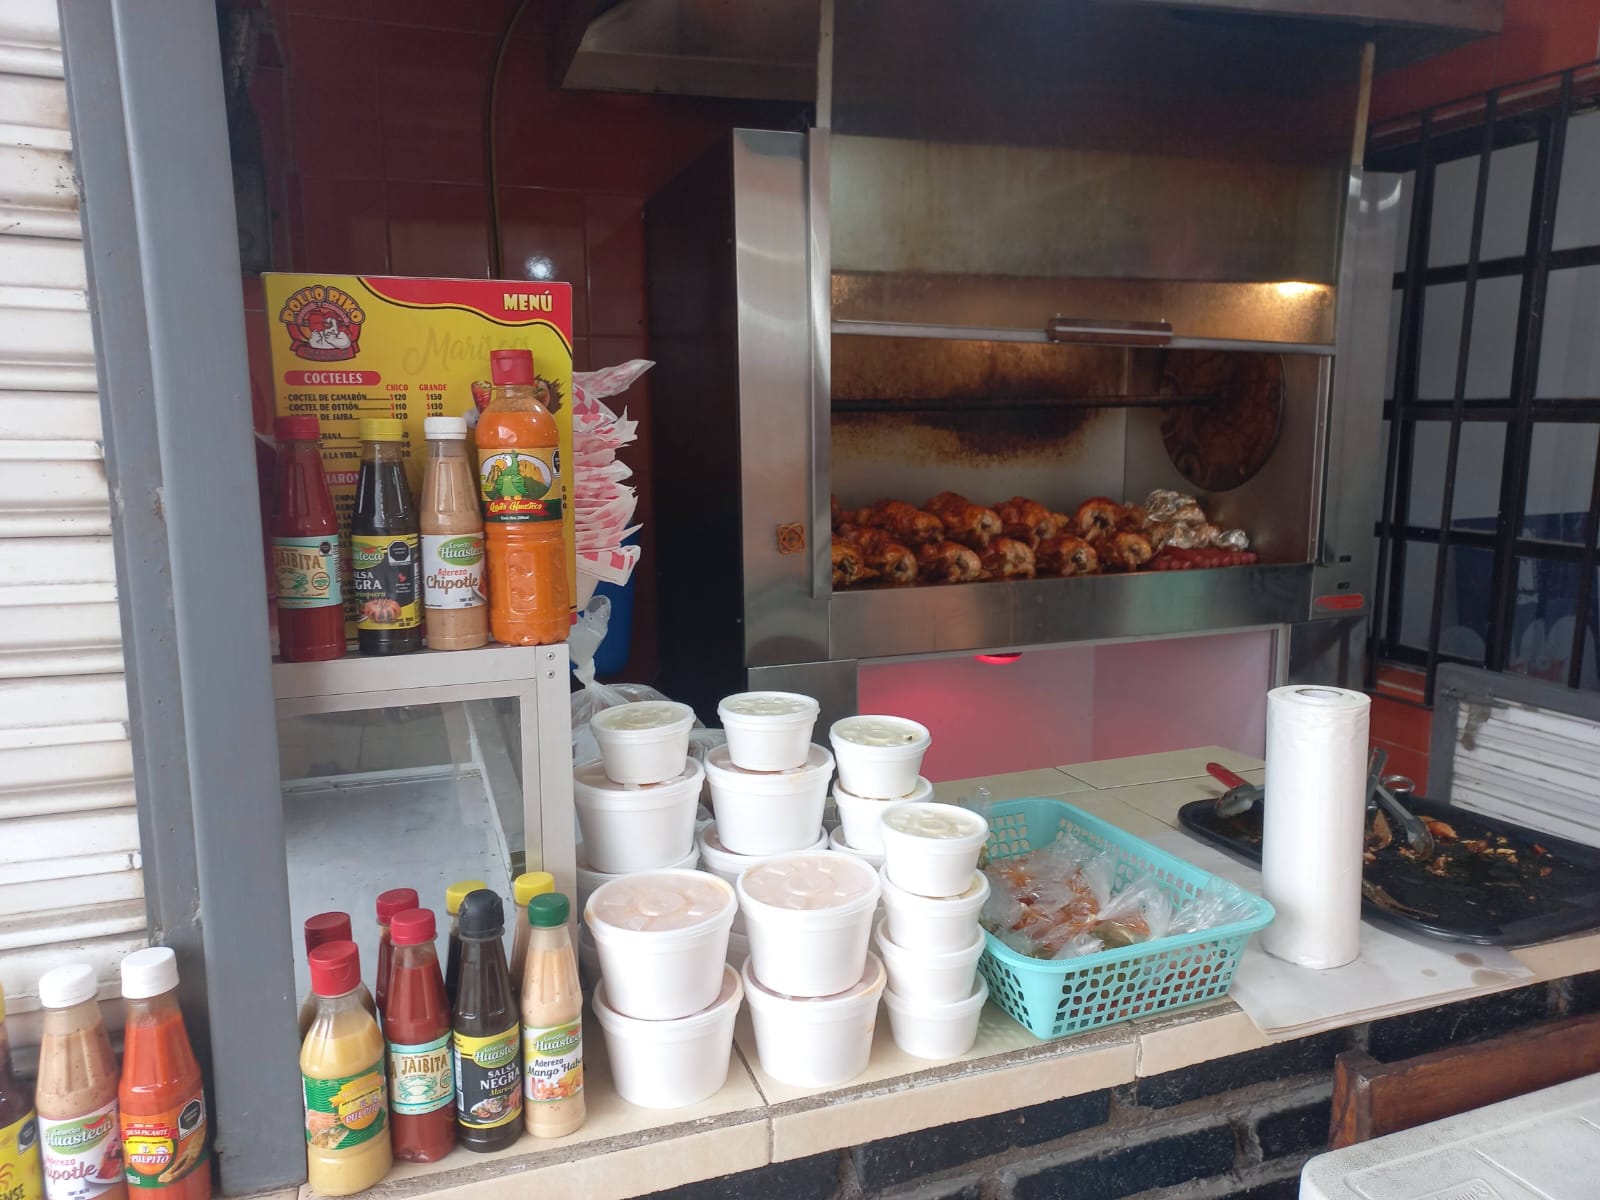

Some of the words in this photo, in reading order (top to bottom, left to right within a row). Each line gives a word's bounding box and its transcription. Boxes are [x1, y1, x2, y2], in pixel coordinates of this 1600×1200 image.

[280, 285, 325, 323] POLLO
[326, 286, 365, 324] RIKO
[503, 290, 552, 312] MENÚ
[304, 372, 363, 384] COCTELES
[418, 383, 448, 391] GRANDE
[331, 392, 367, 401] CAMARÓN
[288, 403, 318, 411] COCTEL
[319, 403, 330, 411] DE
[331, 402, 360, 411] OSTIÓN
[320, 413, 331, 421] DE
[438, 568, 467, 576] Aderezo
[355, 580, 383, 590] GRA
[426, 573, 479, 595] Chipotle
[401, 1054, 448, 1075] JAIBITA
[535, 1059, 564, 1067] Aderezo
[487, 1062, 516, 1079] SALSA
[528, 1066, 560, 1079] Mango
[480, 1067, 520, 1090] NEGRA
[47, 1119, 112, 1147] Huasteca
[131, 1154, 170, 1164] PULPITO
